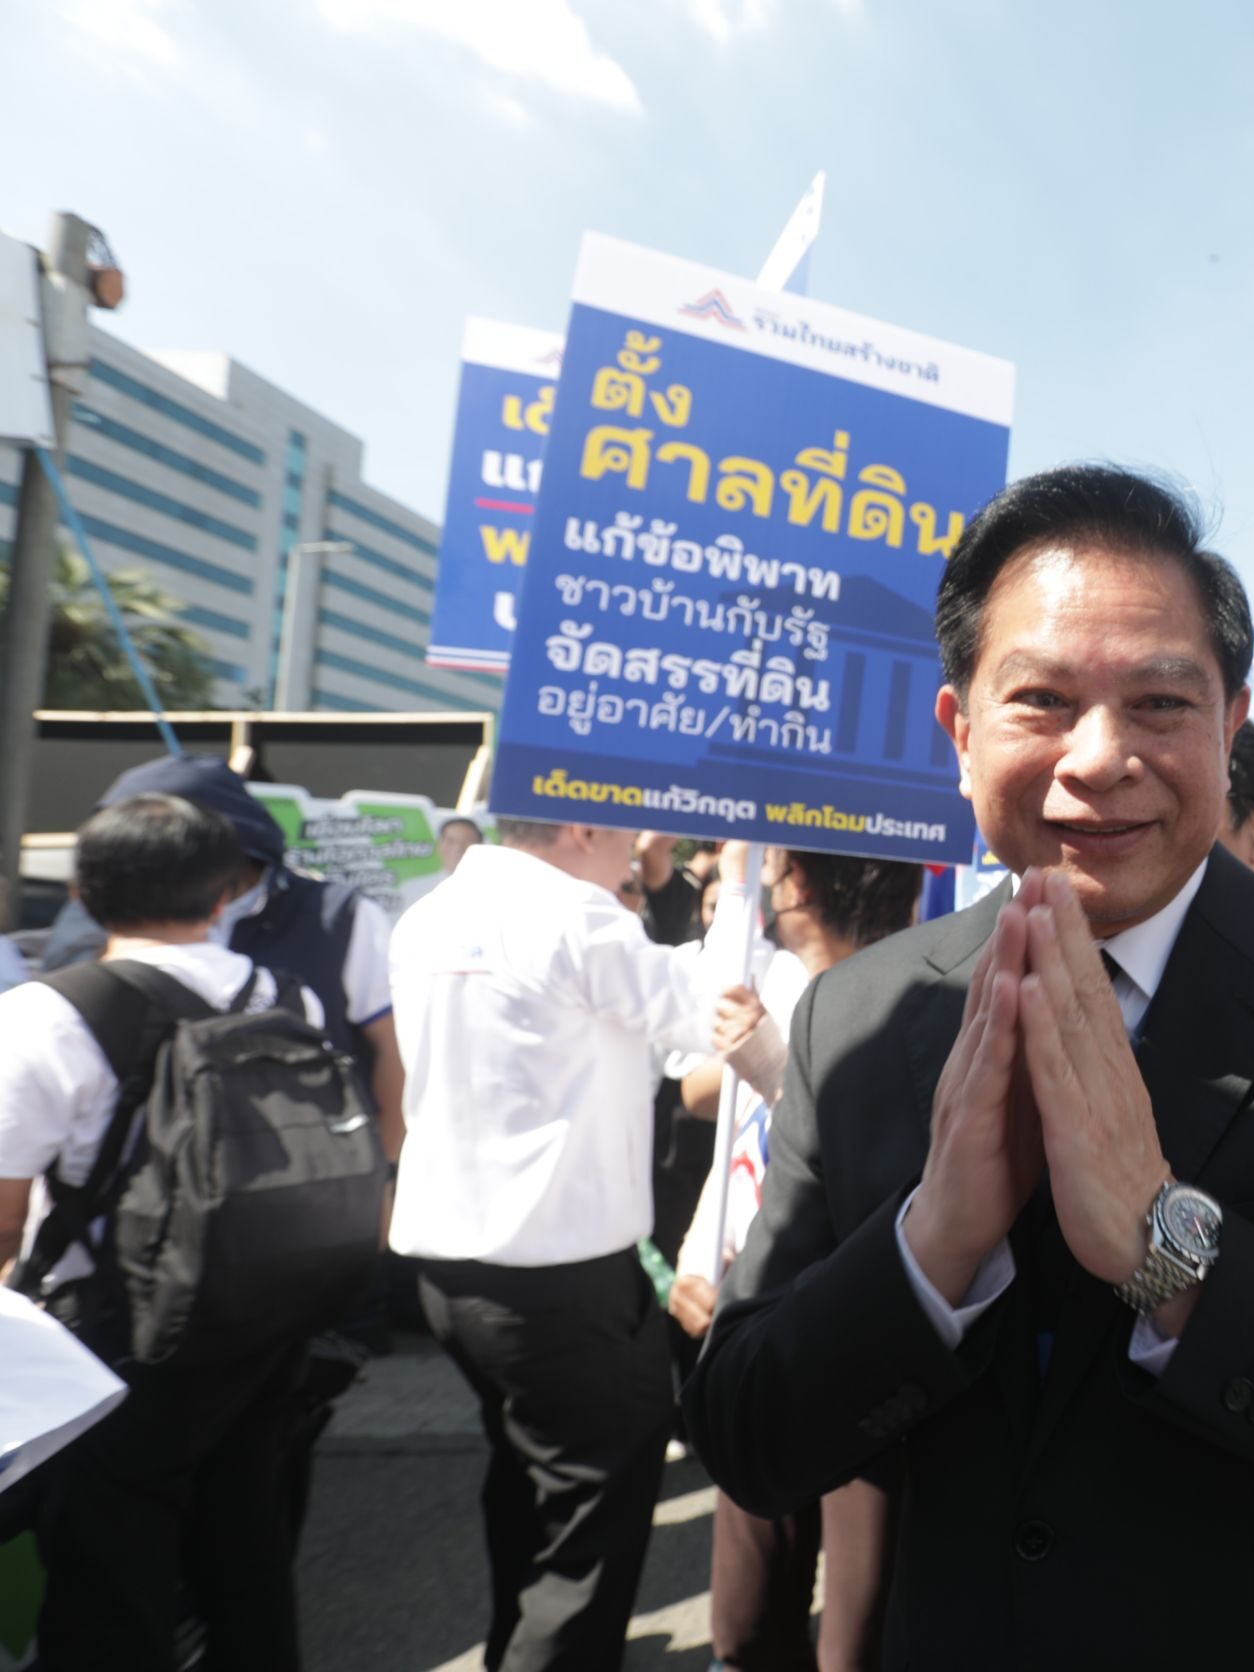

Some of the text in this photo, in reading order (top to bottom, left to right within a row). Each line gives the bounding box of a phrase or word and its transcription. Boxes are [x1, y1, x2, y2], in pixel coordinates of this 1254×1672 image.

[590, 330, 693, 428] ตั้ง
[580, 428, 966, 559] ศาลที่ดิน
[564, 511, 841, 601] แก้ข้อพิพาท
[555, 573, 830, 662] ชาวบ้านกับรัฐ
[545, 619, 831, 712] จัดสรรที่ดิน
[537, 680, 832, 755] อยู่อาศัย/ทำกิน
[532, 769, 947, 843] เด็ดขาดแก้วิกฤต พลิกโฉมประเทศ
